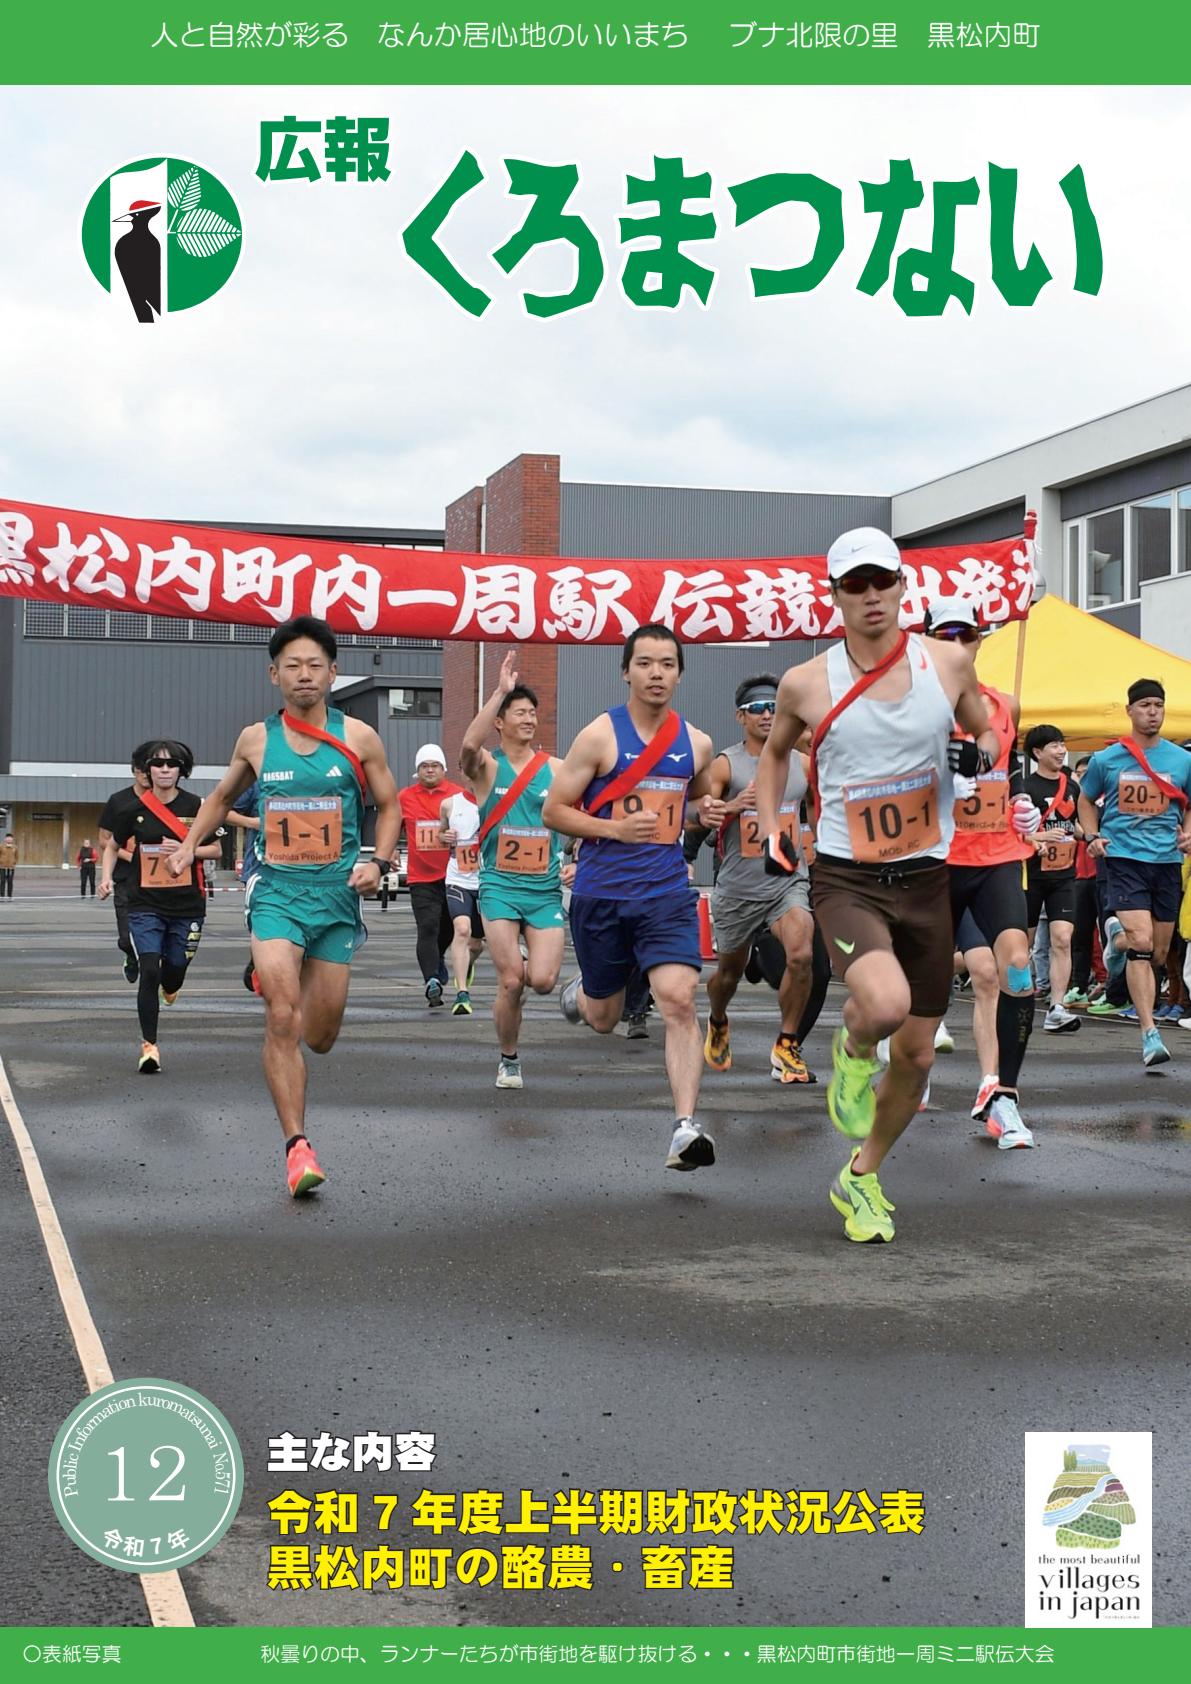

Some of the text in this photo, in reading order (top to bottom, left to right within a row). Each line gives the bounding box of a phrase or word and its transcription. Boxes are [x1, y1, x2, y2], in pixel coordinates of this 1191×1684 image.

[1124, 785, 1165, 804] 20-1
[277, 817, 330, 847] 1-1
[858, 801, 930, 842] 10-1
[269, 853, 299, 861] Yoshida
[301, 852, 331, 862] Project
[504, 840, 543, 862] 2-1
